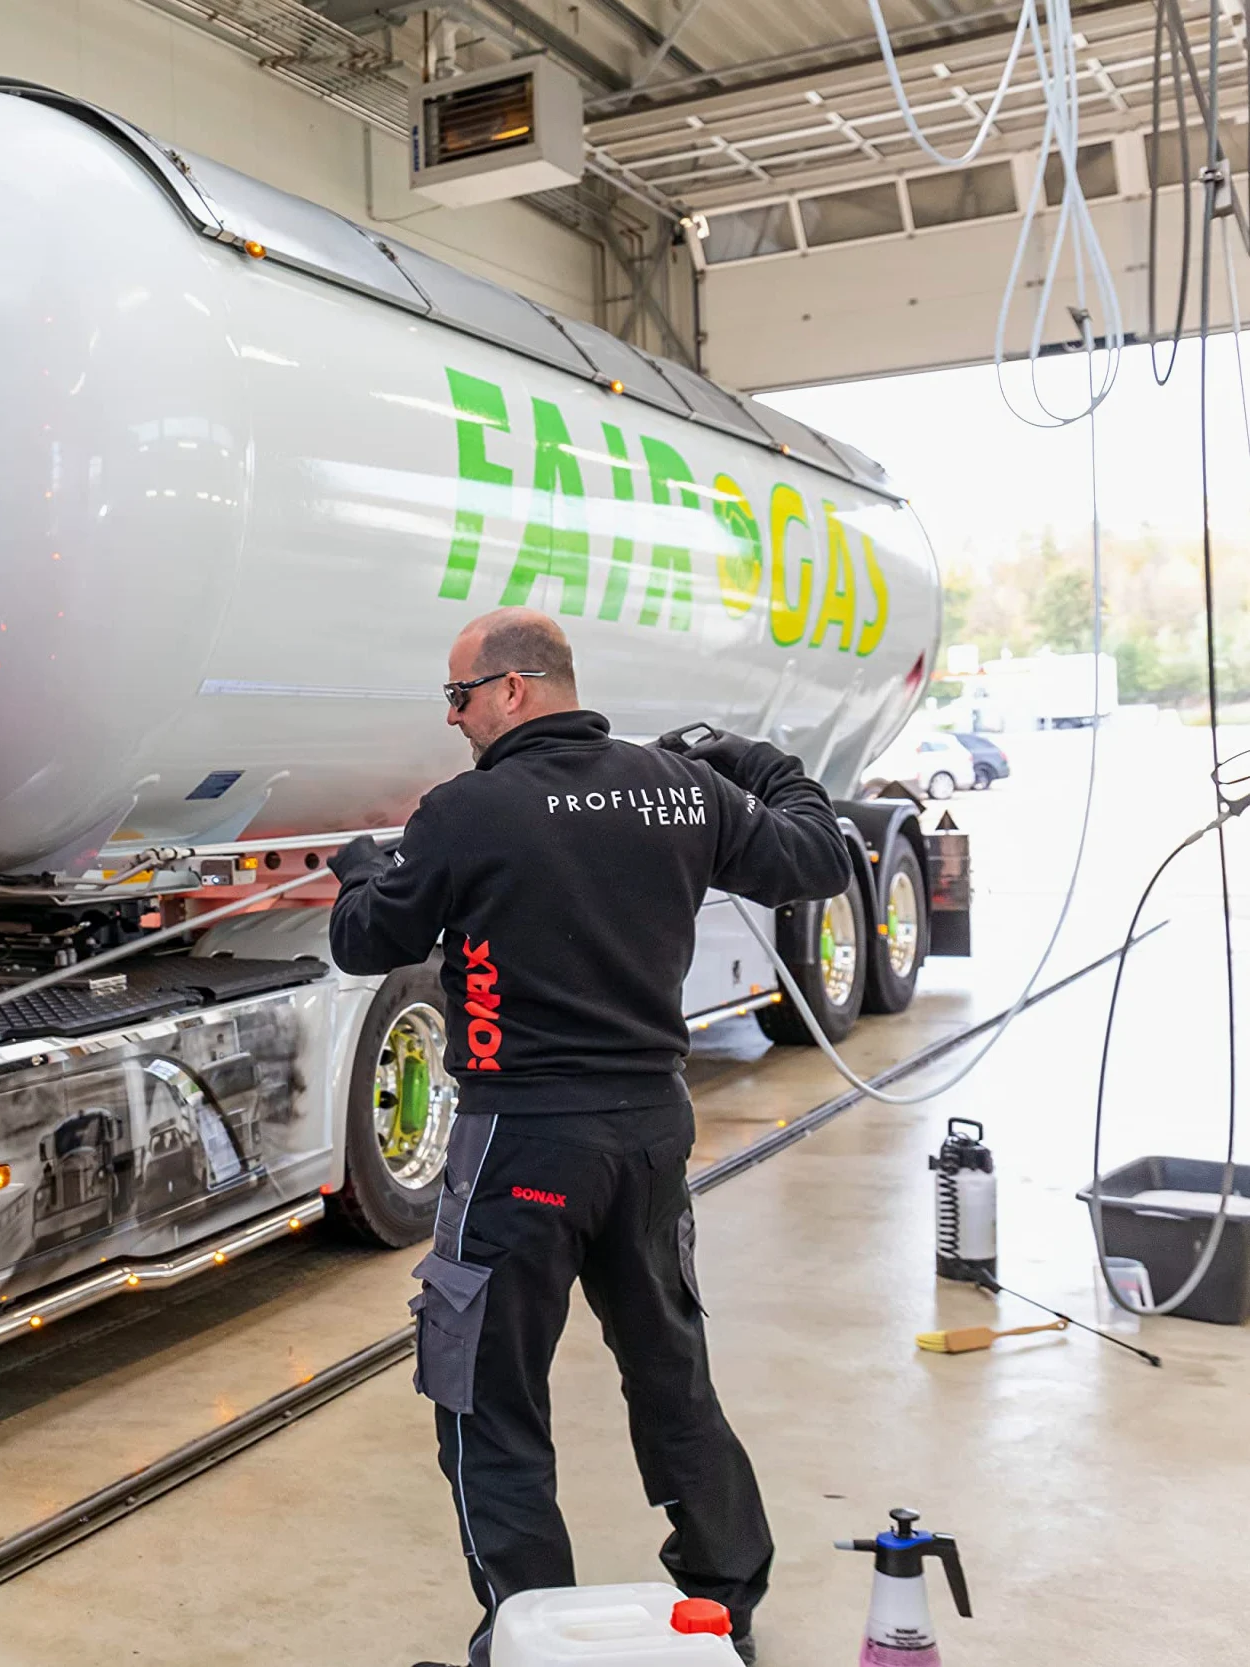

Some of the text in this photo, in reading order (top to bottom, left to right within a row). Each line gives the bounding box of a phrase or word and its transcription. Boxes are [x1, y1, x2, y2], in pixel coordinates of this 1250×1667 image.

[438, 366, 699, 632] FAIR
[547, 787, 705, 813] PROFILINE
[638, 806, 706, 826] TEAM
[511, 1186, 567, 1207] SONAX
